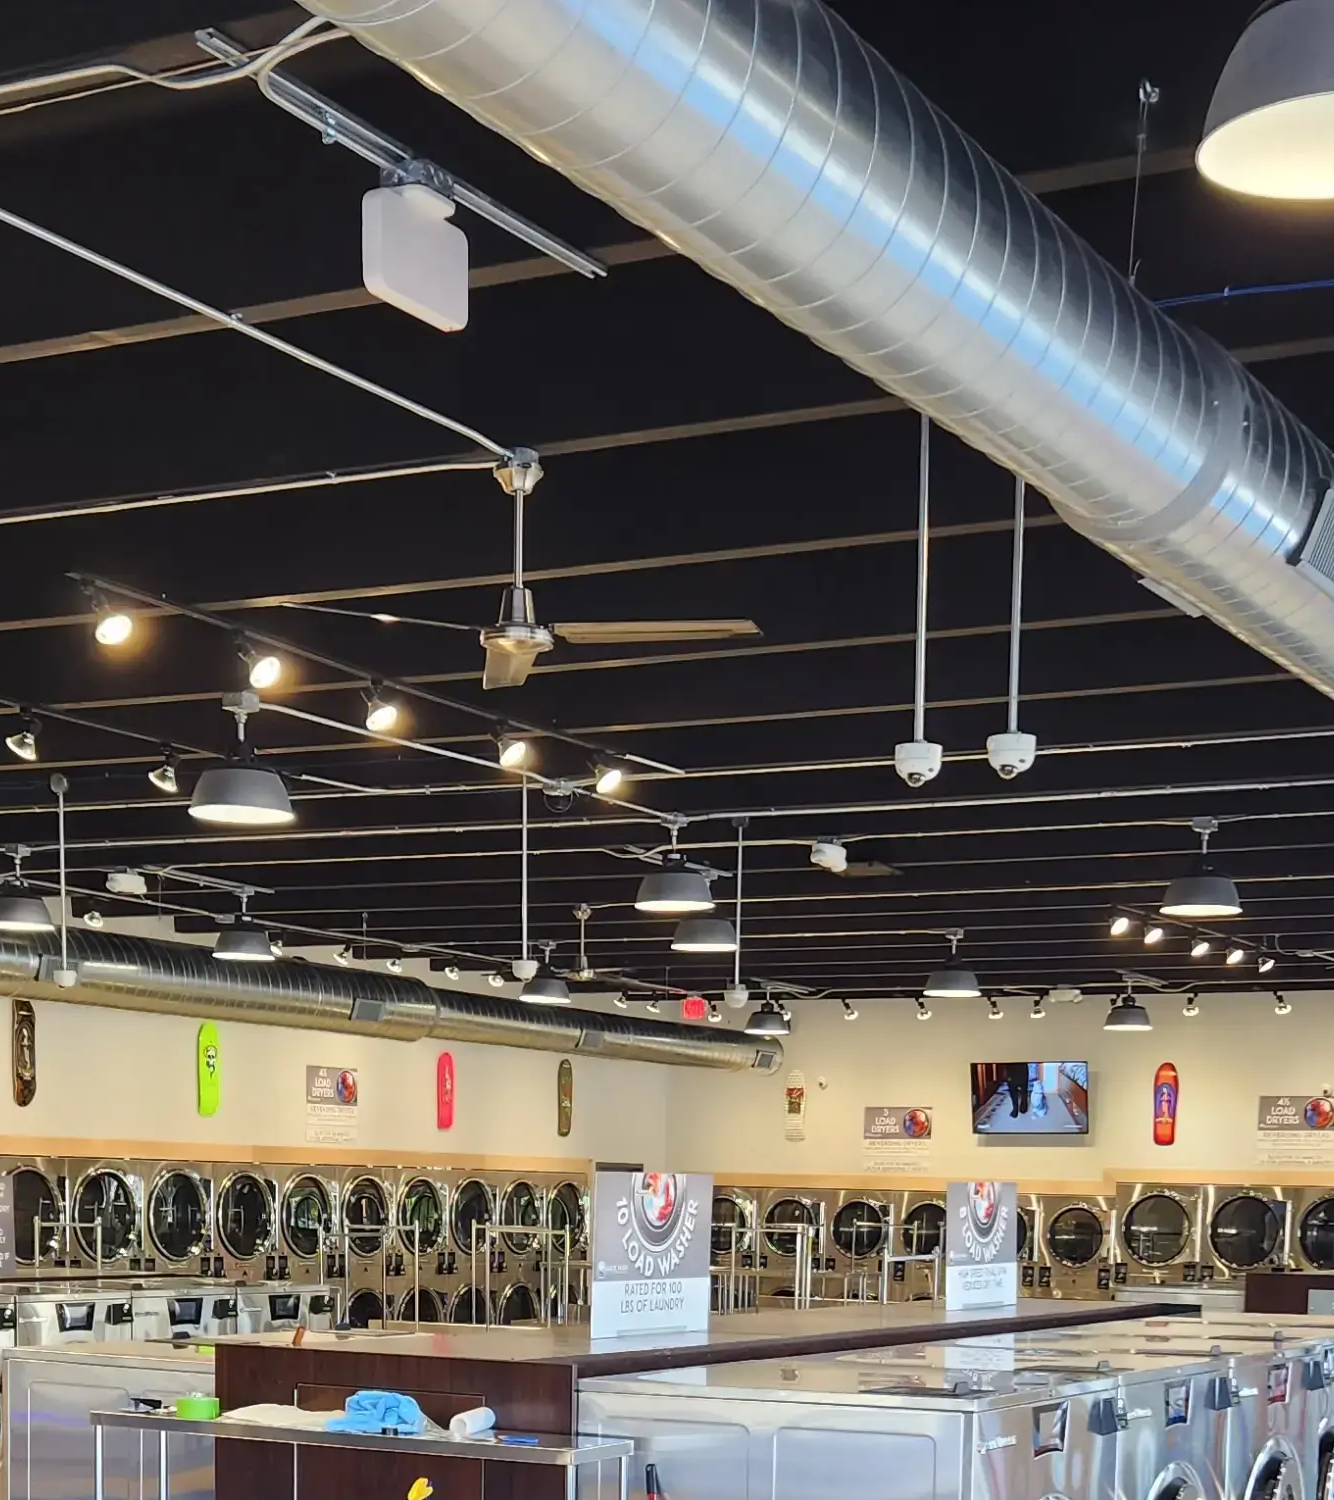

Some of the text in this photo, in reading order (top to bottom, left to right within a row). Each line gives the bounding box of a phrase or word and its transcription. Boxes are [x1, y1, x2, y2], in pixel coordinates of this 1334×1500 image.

[315, 1077, 332, 1088] LOAD
[312, 1087, 335, 1098] DRYERS
[1271, 1106, 1296, 1115] LOAD
[875, 1117, 896, 1125] LOAD
[1266, 1115, 1299, 1124] DRYERS
[871, 1125, 899, 1133] DRYERS
[616, 1196, 699, 1277] 10 LOAD WASHER
[962, 1222, 981, 1262] LOAD
[982, 1206, 1008, 1262] WASHER
[4, 1252, 11, 1260] IF
[624, 1281, 683, 1297] RATED FOR 100
[620, 1297, 685, 1314] LBS OF LAUNDRY
